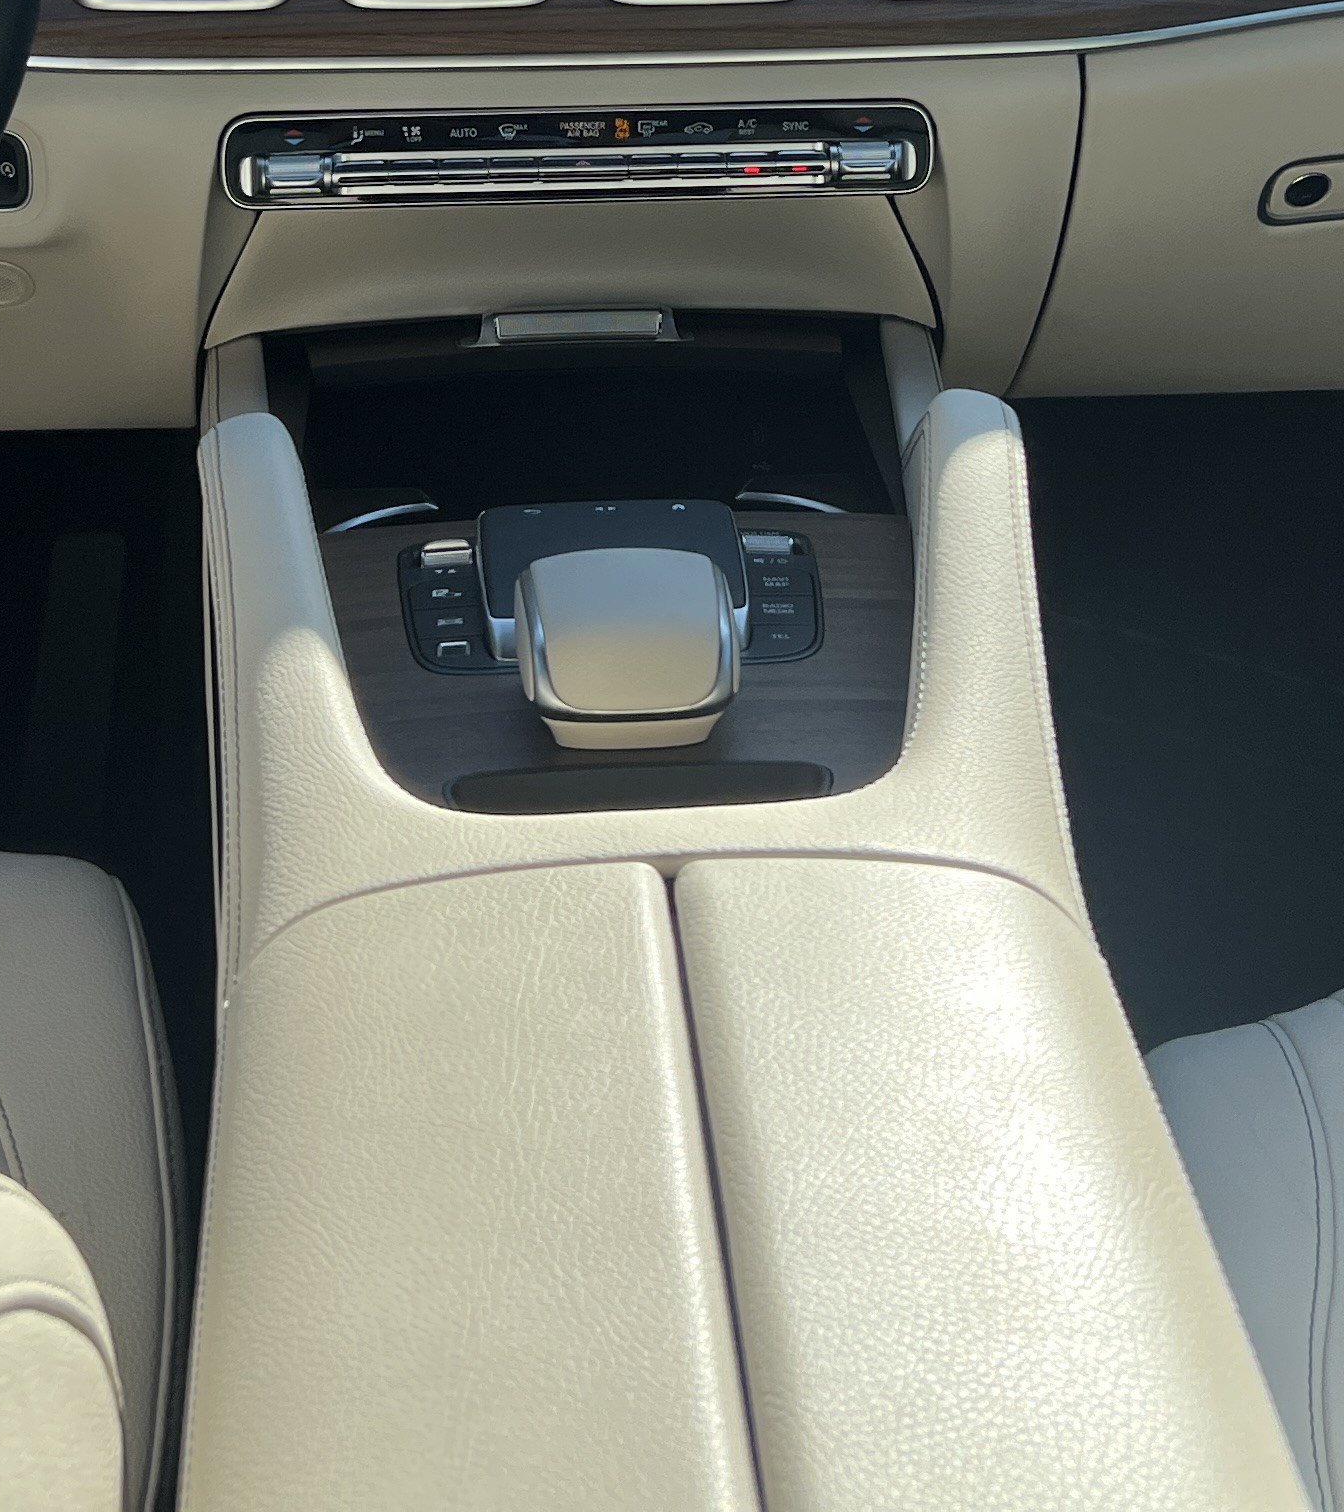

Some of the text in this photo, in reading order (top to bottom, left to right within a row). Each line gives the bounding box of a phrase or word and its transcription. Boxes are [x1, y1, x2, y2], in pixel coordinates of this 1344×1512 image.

[559, 120, 606, 131] PASSENGER
[737, 119, 757, 130] A/C
[782, 121, 810, 132] SYNC
[449, 127, 478, 139] AUTO
[567, 129, 600, 138] AIR BAG
